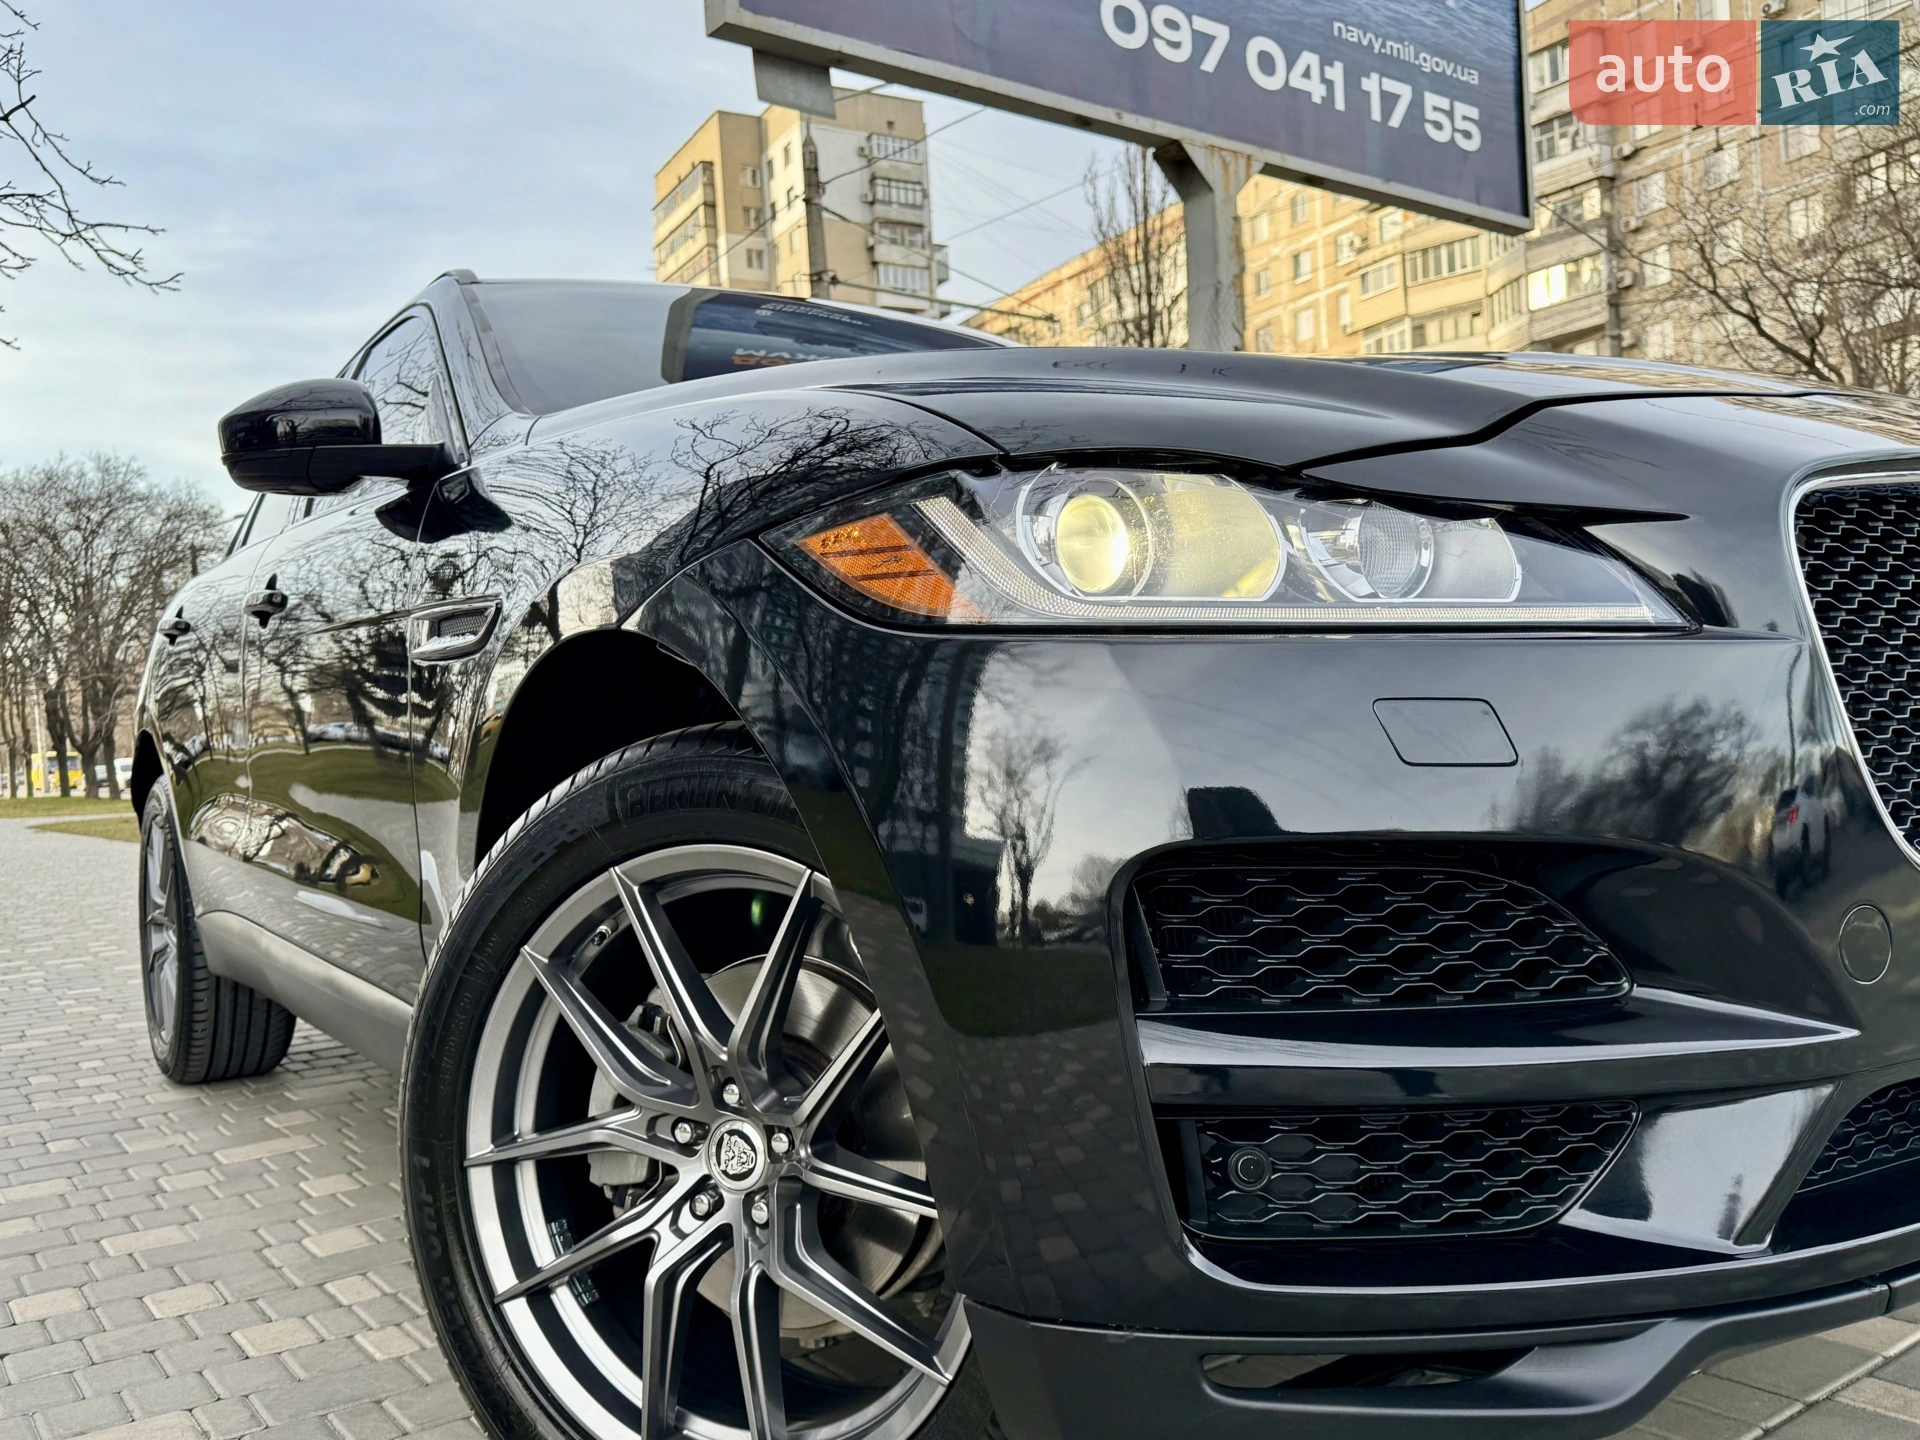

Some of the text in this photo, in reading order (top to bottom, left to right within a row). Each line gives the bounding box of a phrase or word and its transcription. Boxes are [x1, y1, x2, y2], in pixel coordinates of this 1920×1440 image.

[1100, 0, 1482, 152] 097 041 17 55
[1333, 20, 1480, 86] navy.mil.gov.ua
